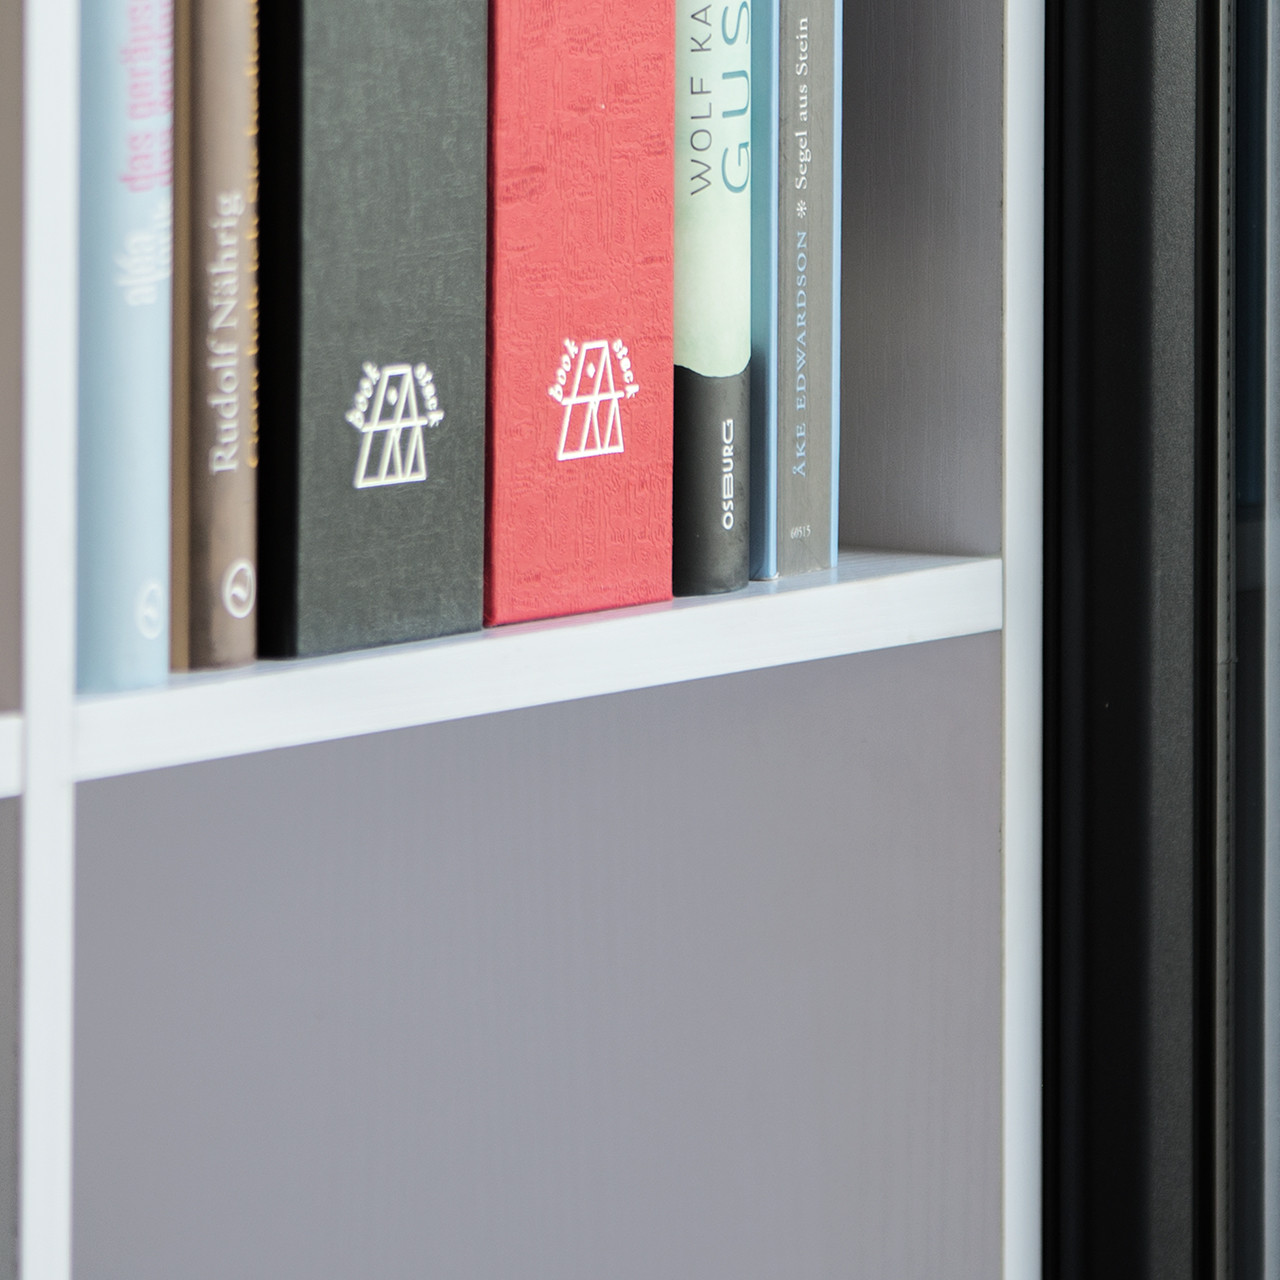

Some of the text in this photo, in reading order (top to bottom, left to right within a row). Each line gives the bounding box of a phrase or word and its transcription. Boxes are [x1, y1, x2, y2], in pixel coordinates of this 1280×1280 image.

[690, 76, 712, 196] WOLF
[795, 17, 812, 190] Segel aus Stein
[207, 193, 244, 474] Rudolf Nährig
[792, 231, 808, 478] ÅKE EDWARDSON
[722, 419, 734, 530] OSBURG
